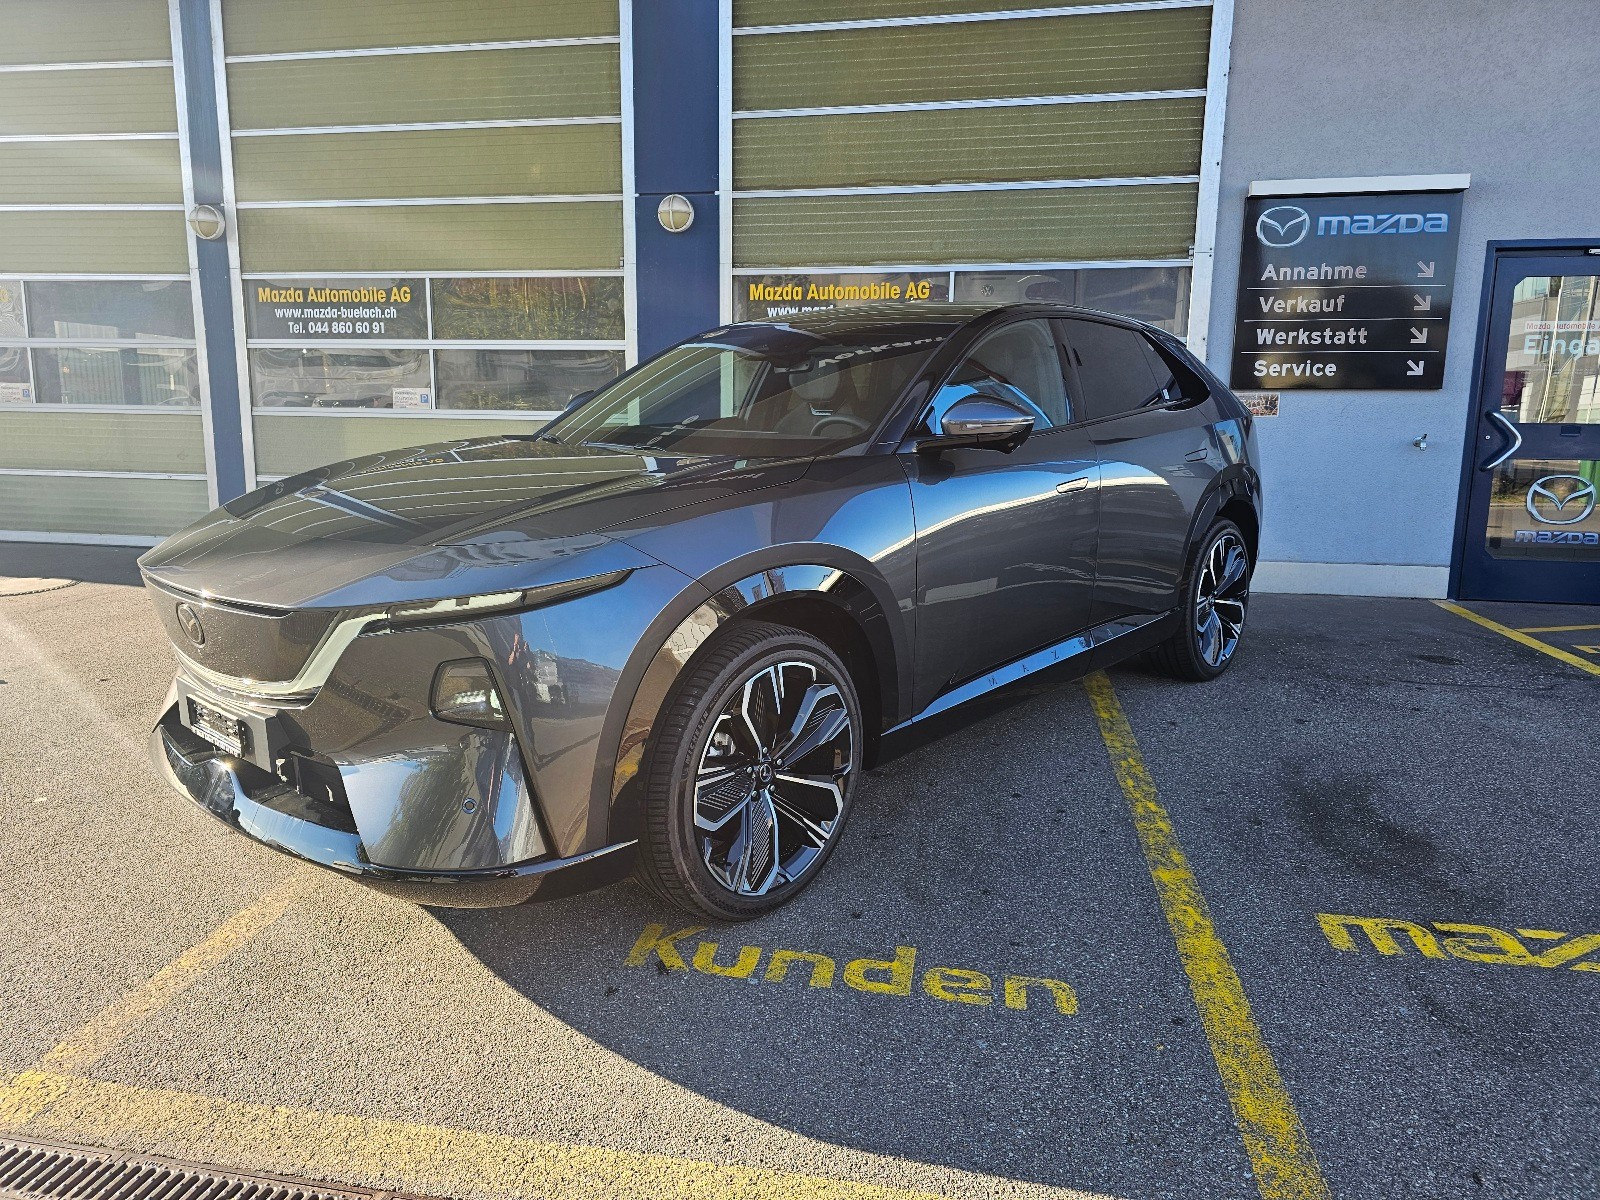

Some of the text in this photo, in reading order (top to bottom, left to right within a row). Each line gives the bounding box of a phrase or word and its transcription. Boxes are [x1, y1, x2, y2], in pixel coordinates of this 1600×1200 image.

[1260, 263, 1367, 281] Annahme
[257, 286, 411, 303] Mazda Automobile AG
[749, 281, 930, 301] Mazda Automobile AG
[274, 306, 397, 319] www.mazda-buelach.ch
[1259, 294, 1345, 313] Verkauf
[287, 321, 385, 334] Tel. 044 860 60 91
[1256, 327, 1368, 345] Werkstatt
[1253, 360, 1337, 377] Service
[623, 922, 1079, 1016] Kunden
